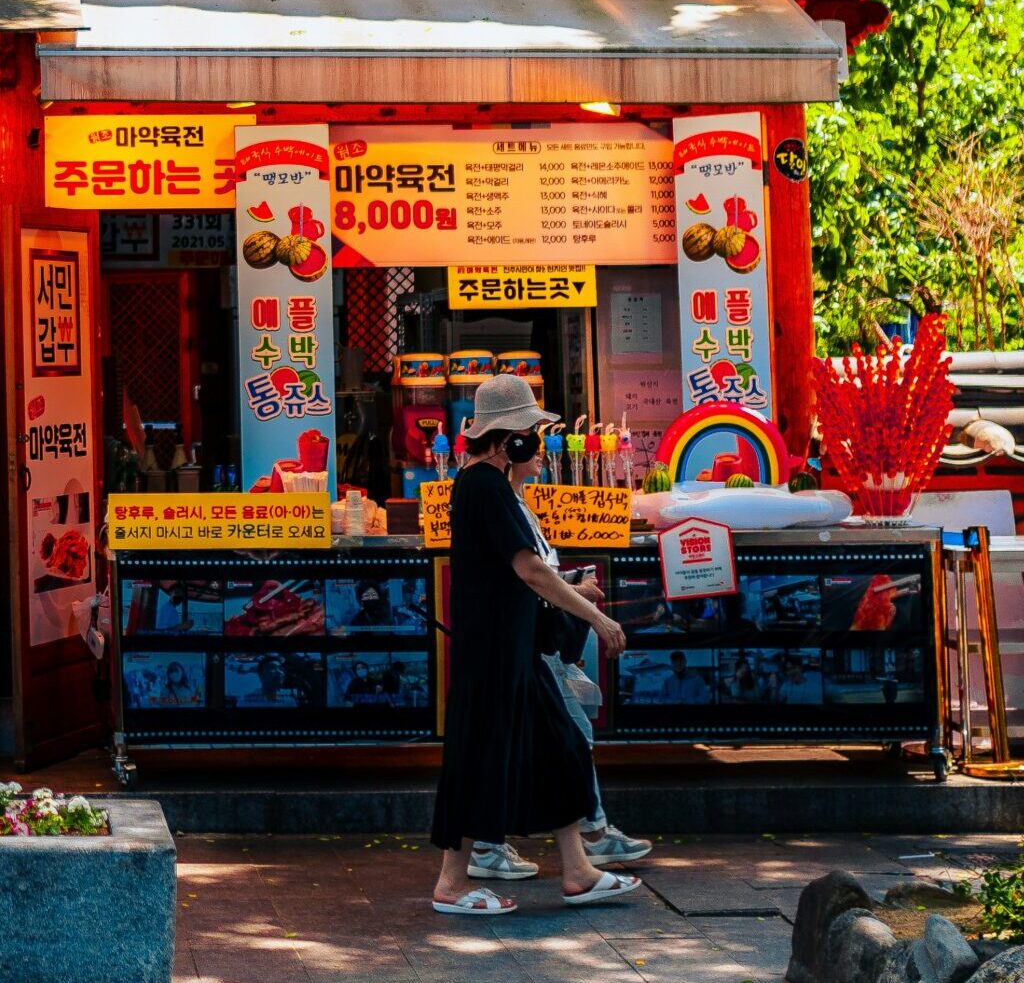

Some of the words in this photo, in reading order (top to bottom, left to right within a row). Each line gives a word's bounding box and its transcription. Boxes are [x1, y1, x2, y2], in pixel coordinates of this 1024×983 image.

[116, 126, 204, 147] 마약육전
[539, 163, 565, 172] 14,000
[648, 162, 674, 171] 13,000
[54, 159, 202, 196] 주문하는
[335, 163, 456, 193] 마약육전
[540, 177, 566, 186] 12,000
[649, 176, 674, 185] 12,000
[540, 192, 566, 201] 13,000
[651, 191, 675, 199] 11,000
[541, 206, 567, 215] 13,000
[651, 205, 675, 214] 11,000
[334, 200, 458, 234] 8,000원
[541, 220, 567, 229] 12,000
[652, 219, 676, 228] 5,000
[542, 235, 568, 244] 12,000
[652, 235, 676, 243] 5,000
[37, 264, 72, 310] 서민
[459, 278, 570, 301] 주문하는곳
[30, 423, 87, 460] 마약육전
[114, 505, 159, 521] 탕후루,
[211, 505, 237, 519] 모든
[156, 526, 194, 539] 마시고
[198, 526, 223, 539] 바로
[227, 524, 284, 539] 카운터로
[288, 525, 326, 538] 오세요
[680, 537, 711, 546] VISION
